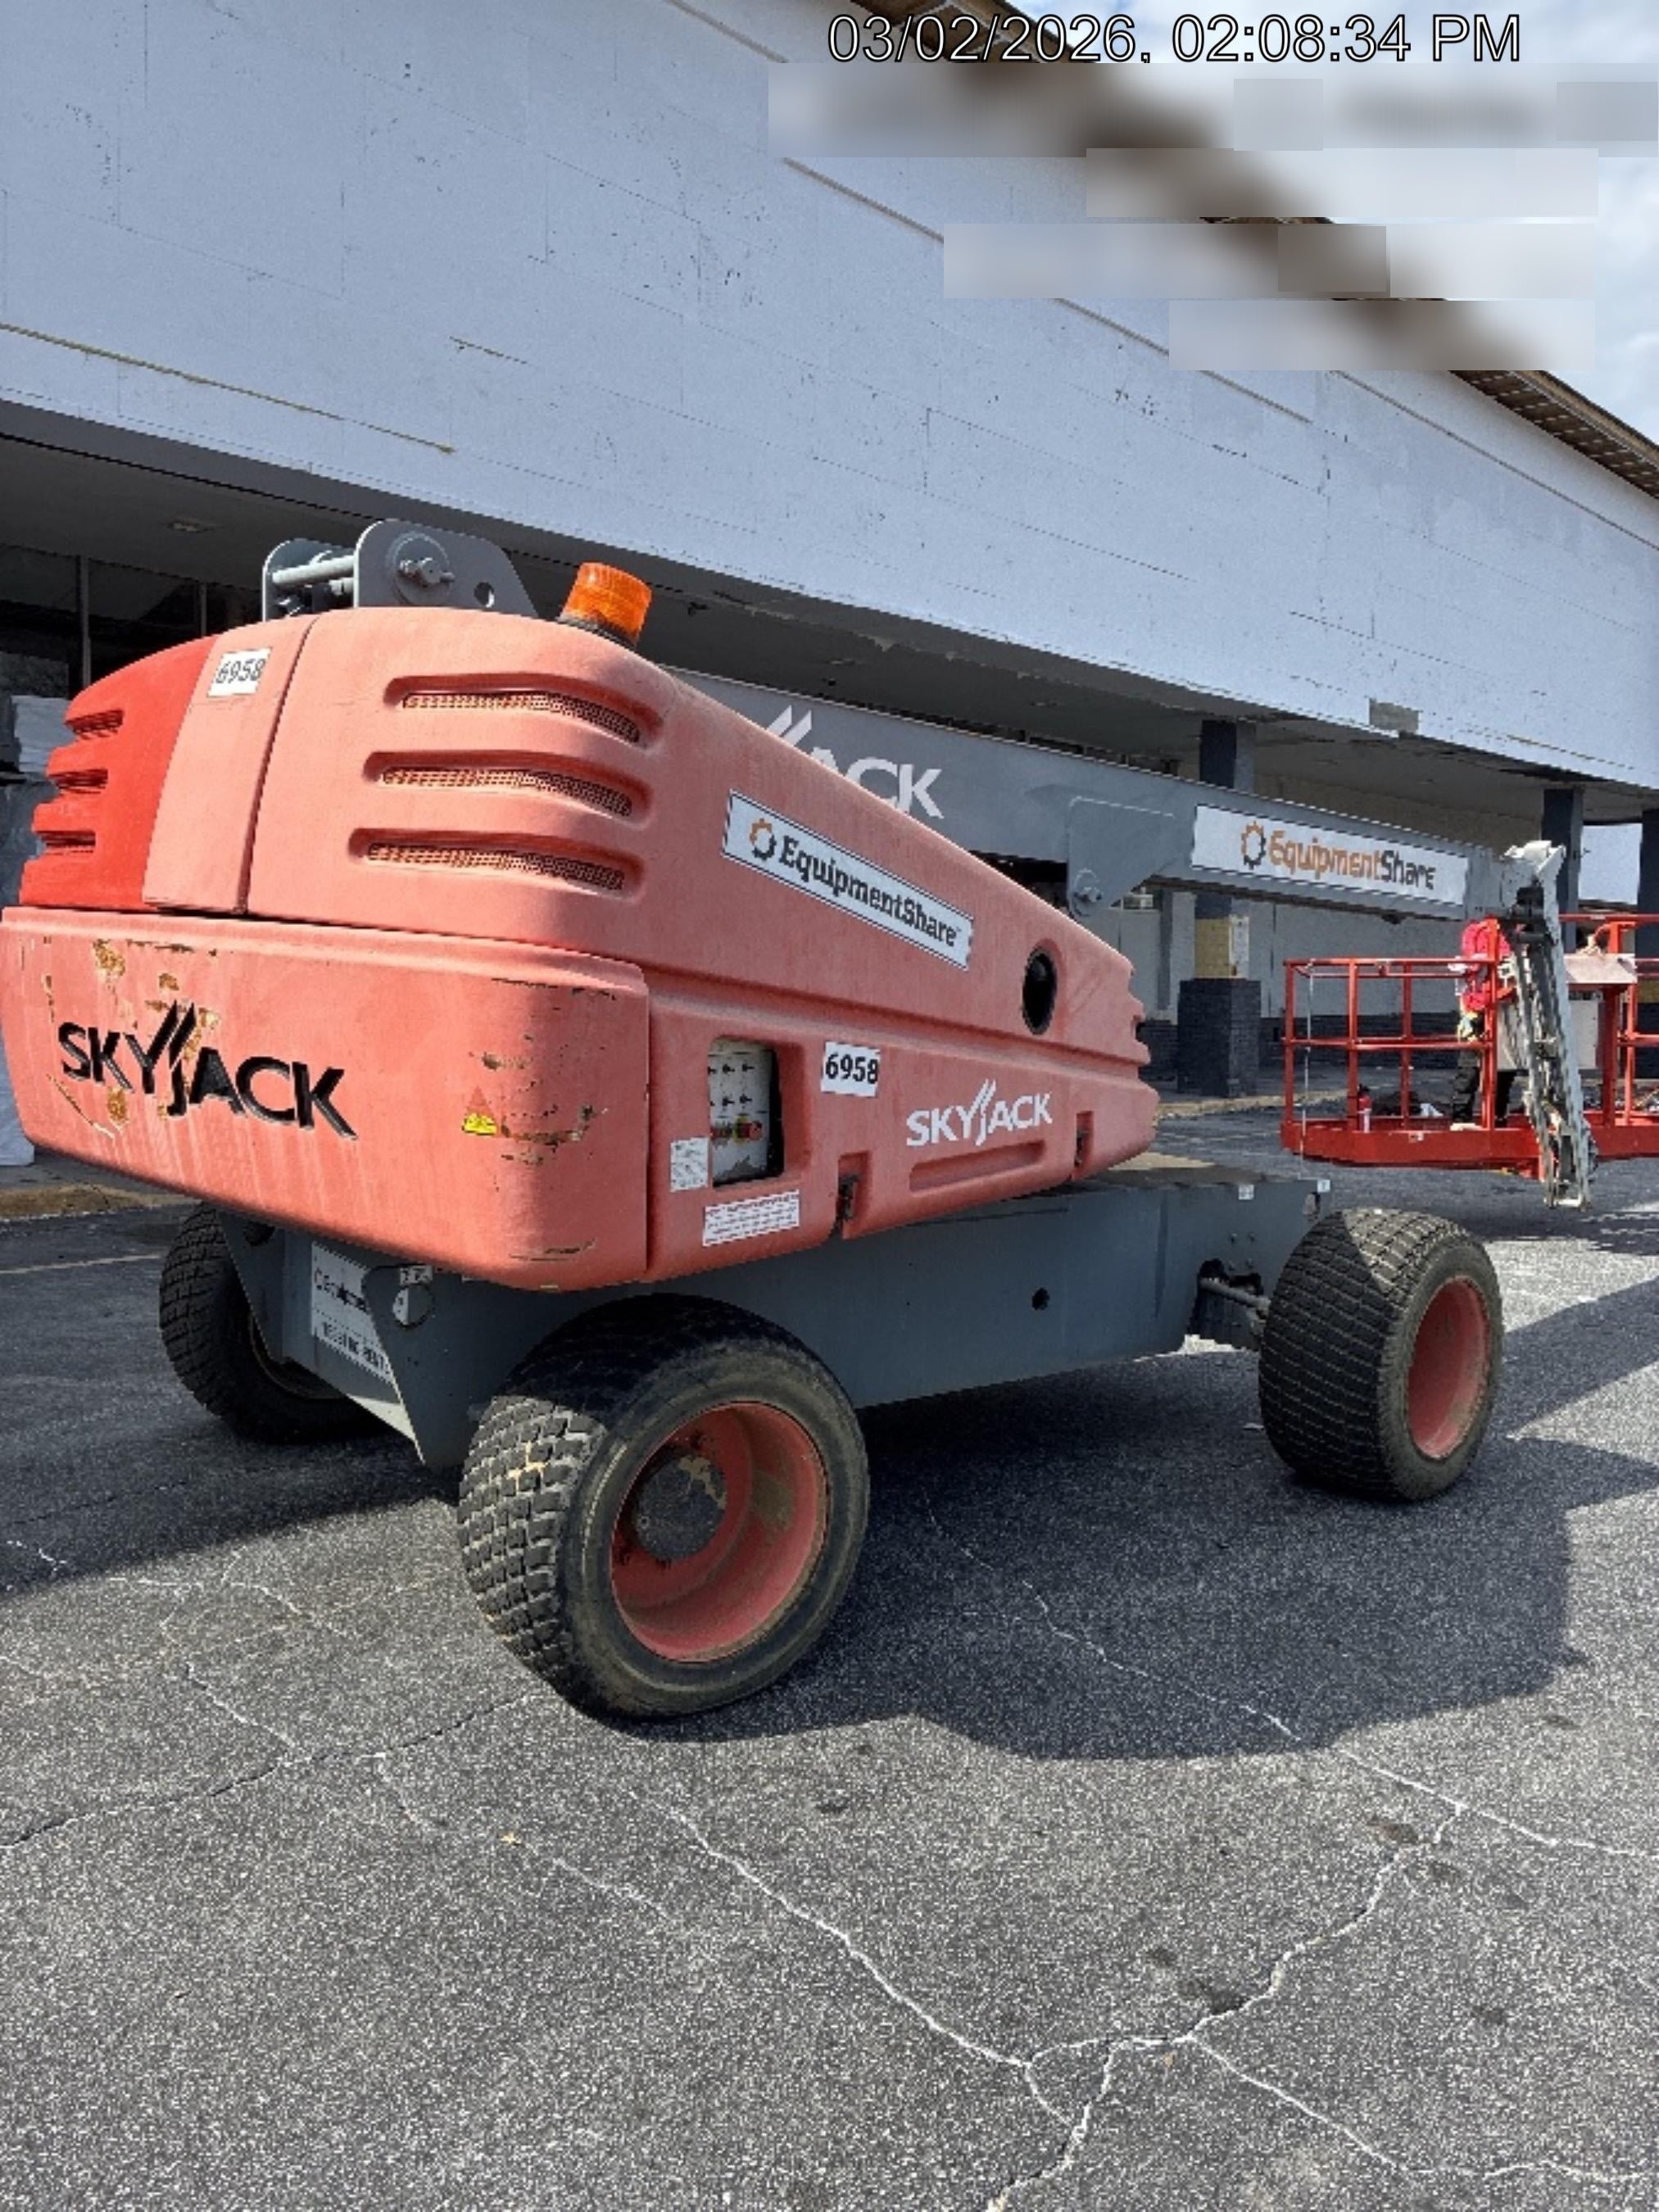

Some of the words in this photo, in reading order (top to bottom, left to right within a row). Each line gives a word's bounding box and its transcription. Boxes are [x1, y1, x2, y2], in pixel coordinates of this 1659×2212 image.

[215, 658, 266, 683] 6958
[779, 835, 959, 947] EquipmentShare
[1269, 830, 1435, 891] EquipmentShare
[57, 999, 358, 1140] SKYJACK
[825, 1052, 879, 1085] 6958
[906, 1078, 1054, 1146] SKYJACK
